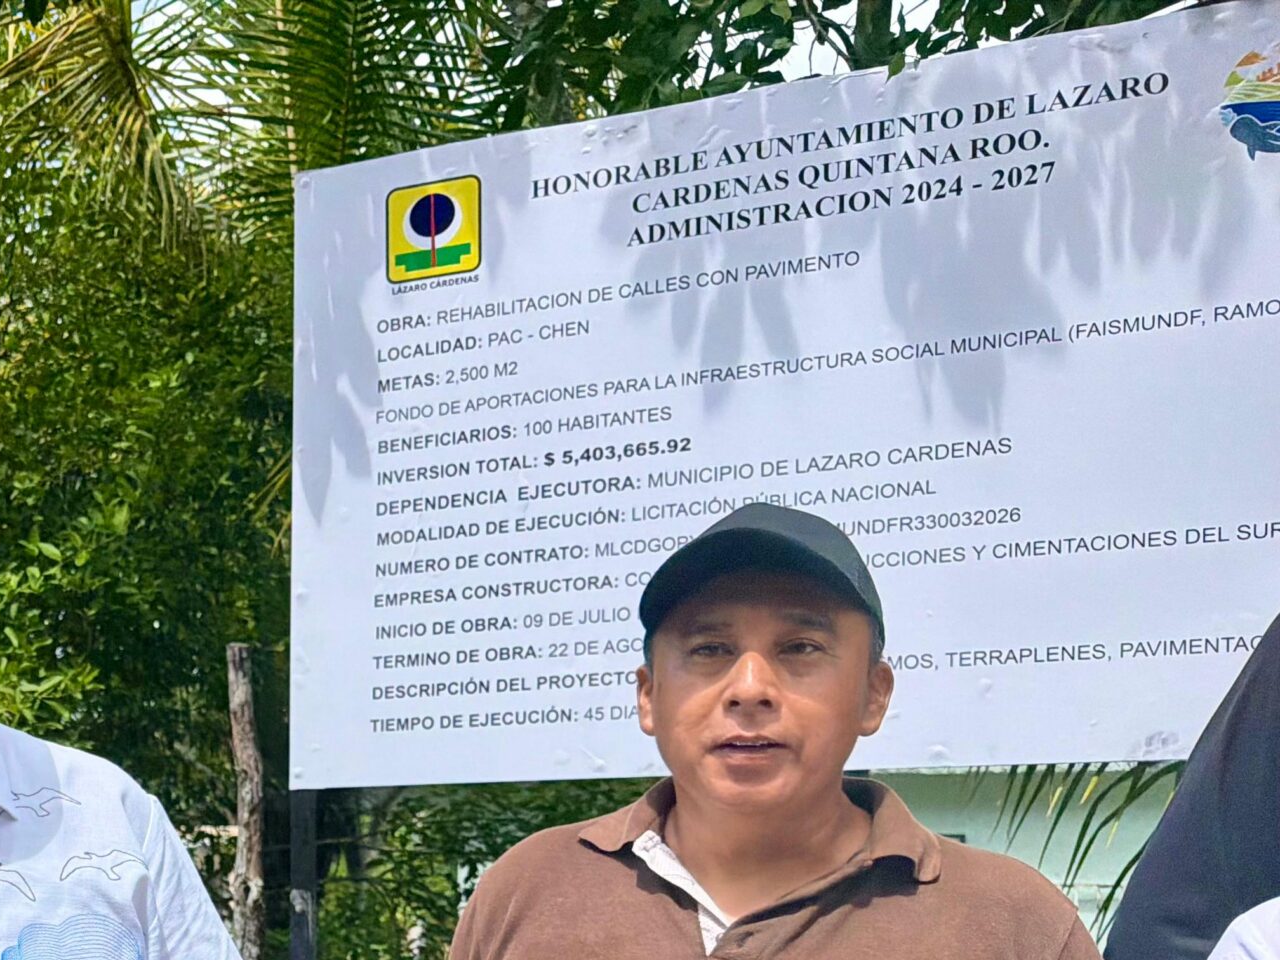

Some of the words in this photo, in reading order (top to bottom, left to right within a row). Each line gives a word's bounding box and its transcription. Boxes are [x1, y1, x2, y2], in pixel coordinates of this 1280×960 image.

[531, 151, 708, 199] HONORABLE
[715, 107, 963, 168] AYUNTAMIENTO
[973, 98, 1016, 125] DE
[1026, 72, 1169, 116] LAZARO
[627, 186, 893, 247] ADMINISTRACION
[902, 175, 963, 204] 2024
[991, 161, 1056, 191] 2027
[632, 170, 789, 214] CARDENAS
[798, 142, 960, 188] QUINTANA
[970, 129, 1050, 160] ROO.
[376, 313, 431, 333] OBRA:
[436, 291, 582, 325] REHABILITACION
[588, 286, 613, 302] DE
[619, 275, 690, 300] CALLES
[696, 267, 738, 288] CON
[745, 250, 860, 281] PAVIMENTO
[375, 404, 434, 424] FONDO
[439, 401, 461, 416] DE
[464, 383, 599, 413] APORTACIONES
[603, 377, 650, 396] PARA
[655, 374, 677, 390] LA
[681, 351, 867, 386] INFRAESTRUCTURA
[871, 342, 945, 364] SOCIAL
[950, 327, 1062, 355] MUNICIPAL
[1068, 309, 1206, 343] (FAISMUNDF,
[1213, 299, 1280, 322] RAMO
[377, 337, 482, 363] LOCALIDAD:
[488, 329, 522, 348] PAC
[539, 320, 590, 340] CHEN
[377, 374, 440, 394] METAS:
[445, 365, 489, 386] 2,500
[493, 361, 518, 377] M2
[377, 425, 517, 454] BENEFICIARIOS:
[523, 420, 552, 437] 100
[558, 406, 672, 433] HABITANTES
[377, 462, 470, 486] INVERSION
[475, 455, 538, 475] TOTAL:
[543, 451, 556, 467] $
[562, 437, 691, 467] 5,403,665.92
[375, 489, 507, 517] DEPENDENCIA
[517, 476, 641, 501] EJECUTORA:
[647, 463, 754, 489] MUNICIPIO
[760, 460, 789, 478] DE
[795, 451, 881, 474] LAZARO
[887, 437, 1012, 466] CARDENAS
[375, 558, 450, 578] NUMERO
[455, 555, 479, 570] DE
[484, 546, 589, 567] CONTRATO:
[595, 535, 694, 558] MLCDGOP
[837, 507, 1021, 537] UNDFR330032026
[376, 523, 480, 546] MODALIDAD
[485, 519, 509, 535] DE
[515, 506, 625, 532] EJECUCIÓN:
[631, 497, 735, 522] LICITACIÓN
[831, 480, 937, 504] NACIONAL
[373, 588, 456, 608] EMPRESA
[462, 575, 618, 600] CONSTRUCTORA:
[972, 544, 986, 561] Y
[992, 530, 1177, 560] CIMENTACIONES
[1185, 526, 1230, 544] DEL
[372, 652, 451, 669] TERMINO
[456, 649, 479, 664] DE
[485, 645, 543, 662] OBRA:
[548, 643, 568, 658] 22
[574, 641, 599, 656] DE
[602, 637, 644, 655] AGO
[376, 624, 427, 640] INICIO
[432, 620, 455, 636] DE
[461, 617, 517, 633] OBRA:
[523, 614, 543, 629] 09
[548, 611, 573, 626] DE
[578, 607, 631, 625] JULIO
[372, 677, 490, 700] DESCRIPCIÓN
[496, 677, 531, 693] DEL
[887, 653, 939, 671] MOS,
[945, 642, 1112, 668] TERRAPLENES,
[1119, 635, 1264, 659] PAVIMENTAC
[370, 716, 434, 733] TIEMPO
[440, 713, 463, 729] DE
[469, 701, 578, 728] EJECUCIÓN:
[584, 707, 605, 721] 45
[610, 705, 639, 721] DIA
